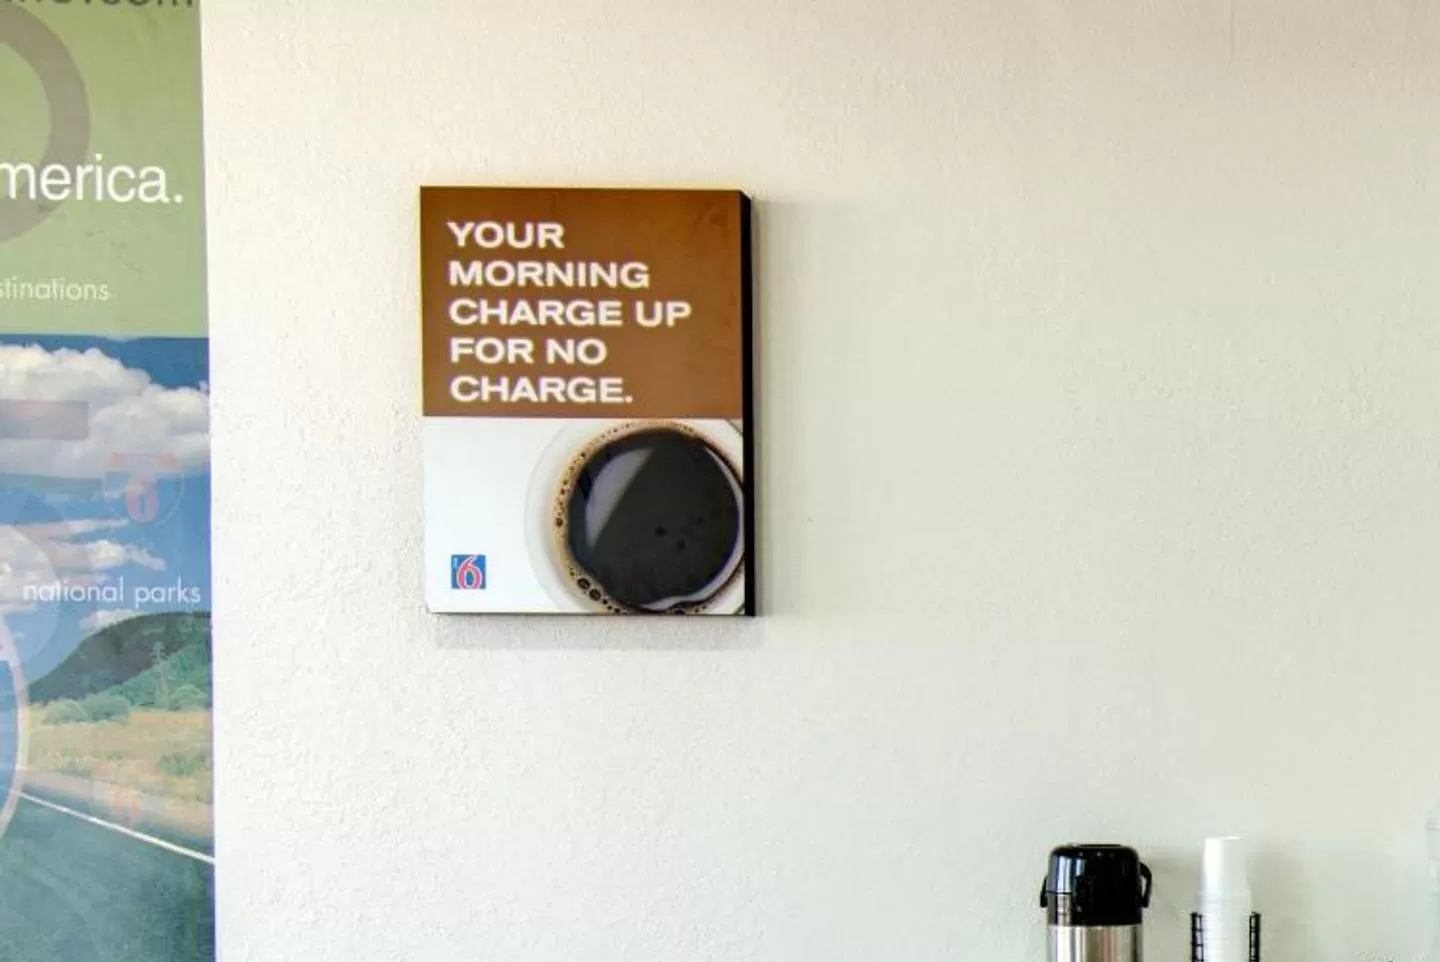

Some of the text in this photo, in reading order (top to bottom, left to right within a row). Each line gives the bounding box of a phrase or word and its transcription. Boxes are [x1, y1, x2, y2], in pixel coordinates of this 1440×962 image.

[0, 153, 183, 203] merica.
[447, 221, 565, 249] YOUR
[448, 260, 651, 289] MORNING
[448, 299, 692, 328] CHARGE UP
[450, 337, 608, 365] FOR NO
[450, 375, 634, 404] CHARGE.
[22, 576, 201, 609] national parks
